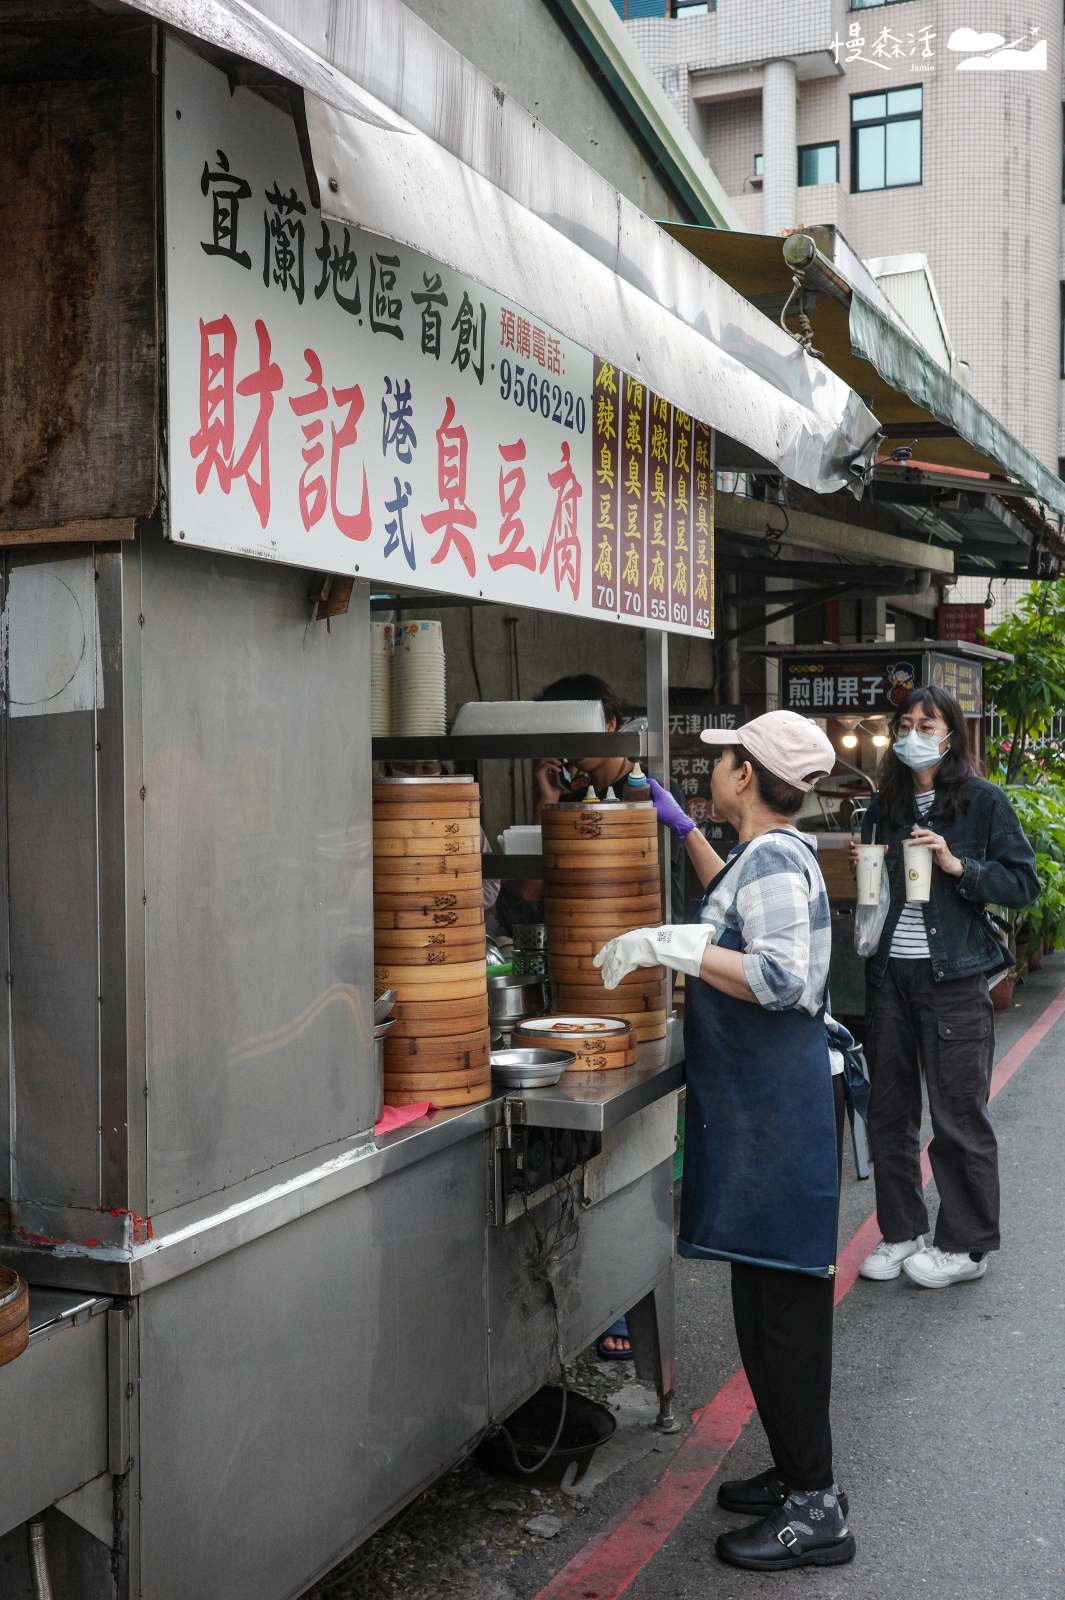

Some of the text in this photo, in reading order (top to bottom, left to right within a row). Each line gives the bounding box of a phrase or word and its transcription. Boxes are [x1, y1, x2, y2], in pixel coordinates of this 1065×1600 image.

[200, 150, 486, 386] 宜蘭地區首創
[499, 358, 586, 435] 9566220
[189, 314, 372, 543] 財記
[381, 375, 418, 571] 港式
[420, 396, 583, 602] 臭豆腐
[596, 585, 615, 608] 70
[624, 590, 641, 613] 70
[650, 597, 667, 619] 55
[673, 602, 688, 624] 60
[695, 607, 710, 628] 45
[945, 612, 979, 620] RICH DAY
[788, 676, 884, 707] 煎餅果子
